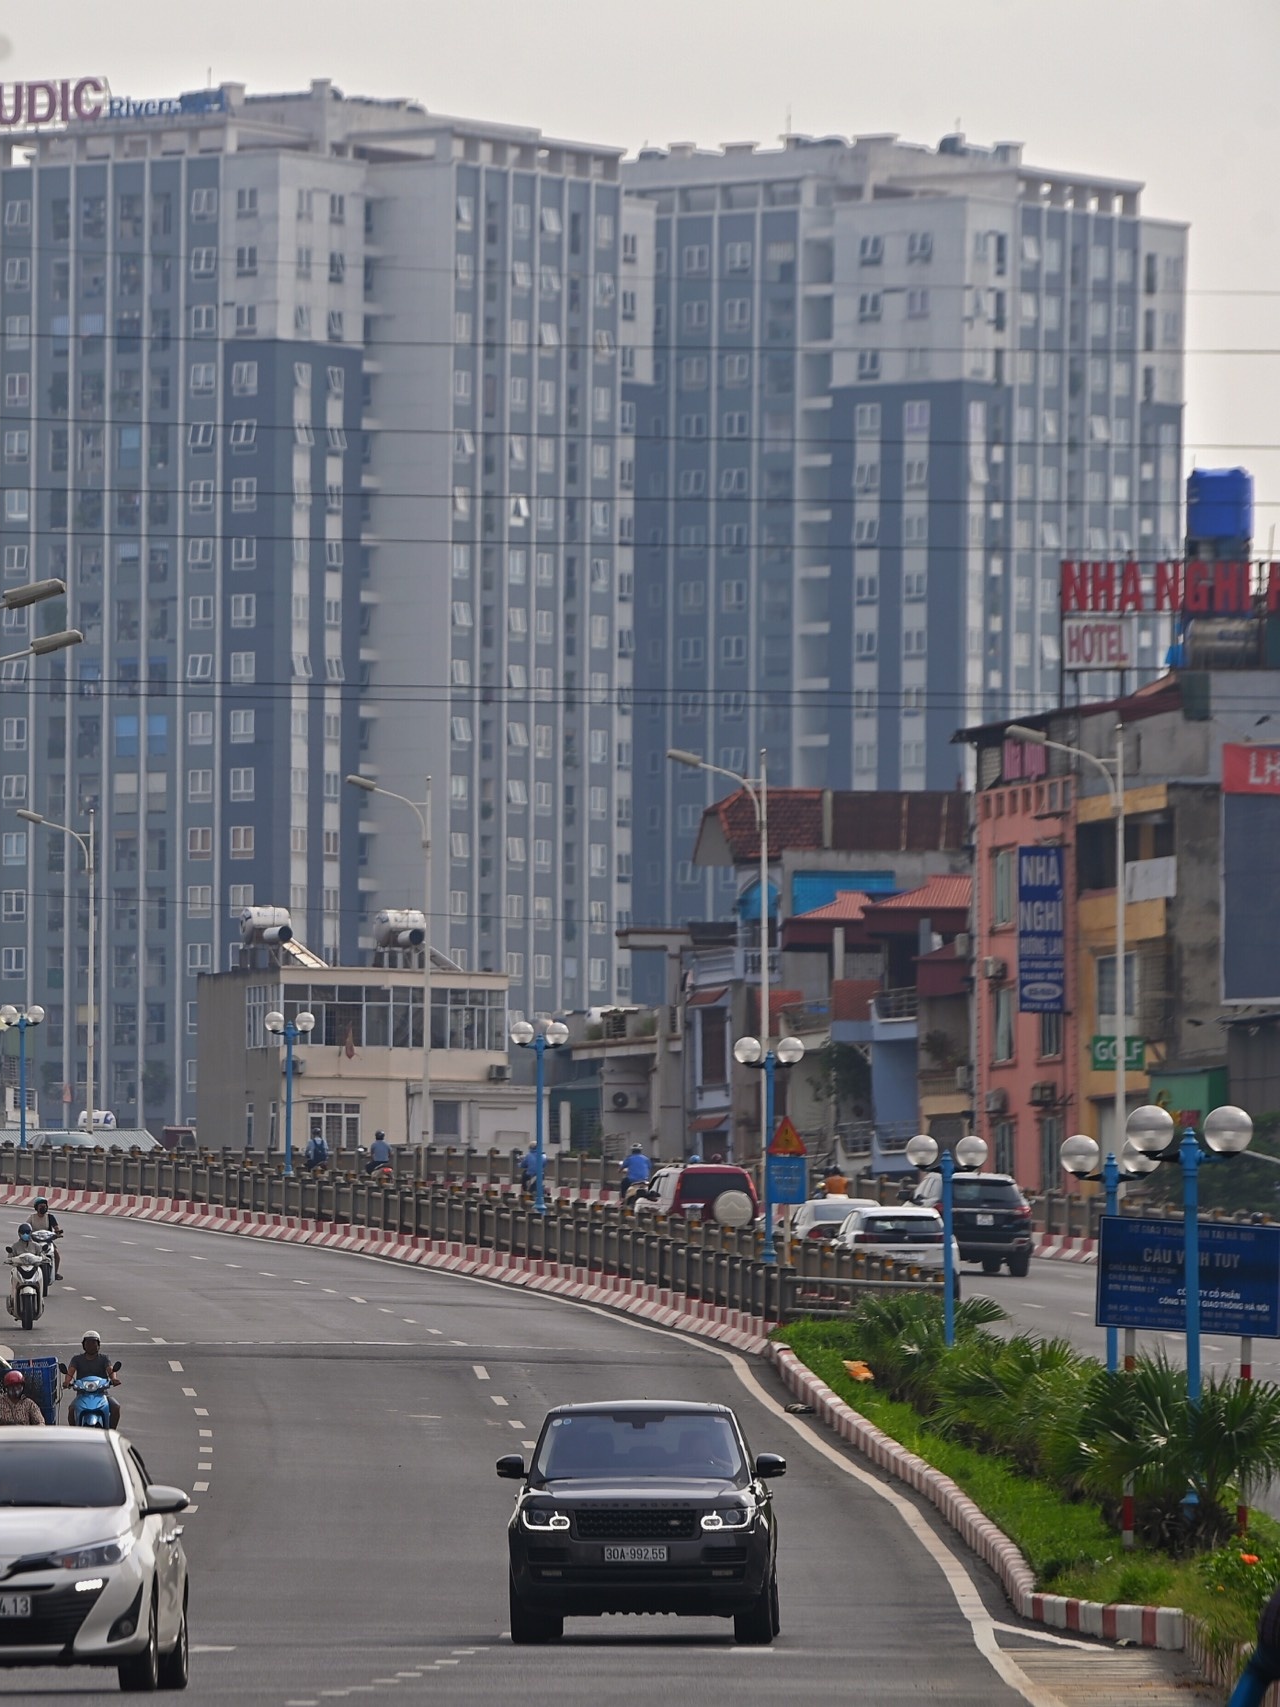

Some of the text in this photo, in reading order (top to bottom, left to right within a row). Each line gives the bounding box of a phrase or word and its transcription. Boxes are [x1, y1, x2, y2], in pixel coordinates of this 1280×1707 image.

[1067, 622, 1129, 663] HOTEL
[1021, 849, 1061, 886] NHÀ
[1019, 889, 1064, 931] NGHỈ
[606, 1548, 665, 1560] 30A-992.55
